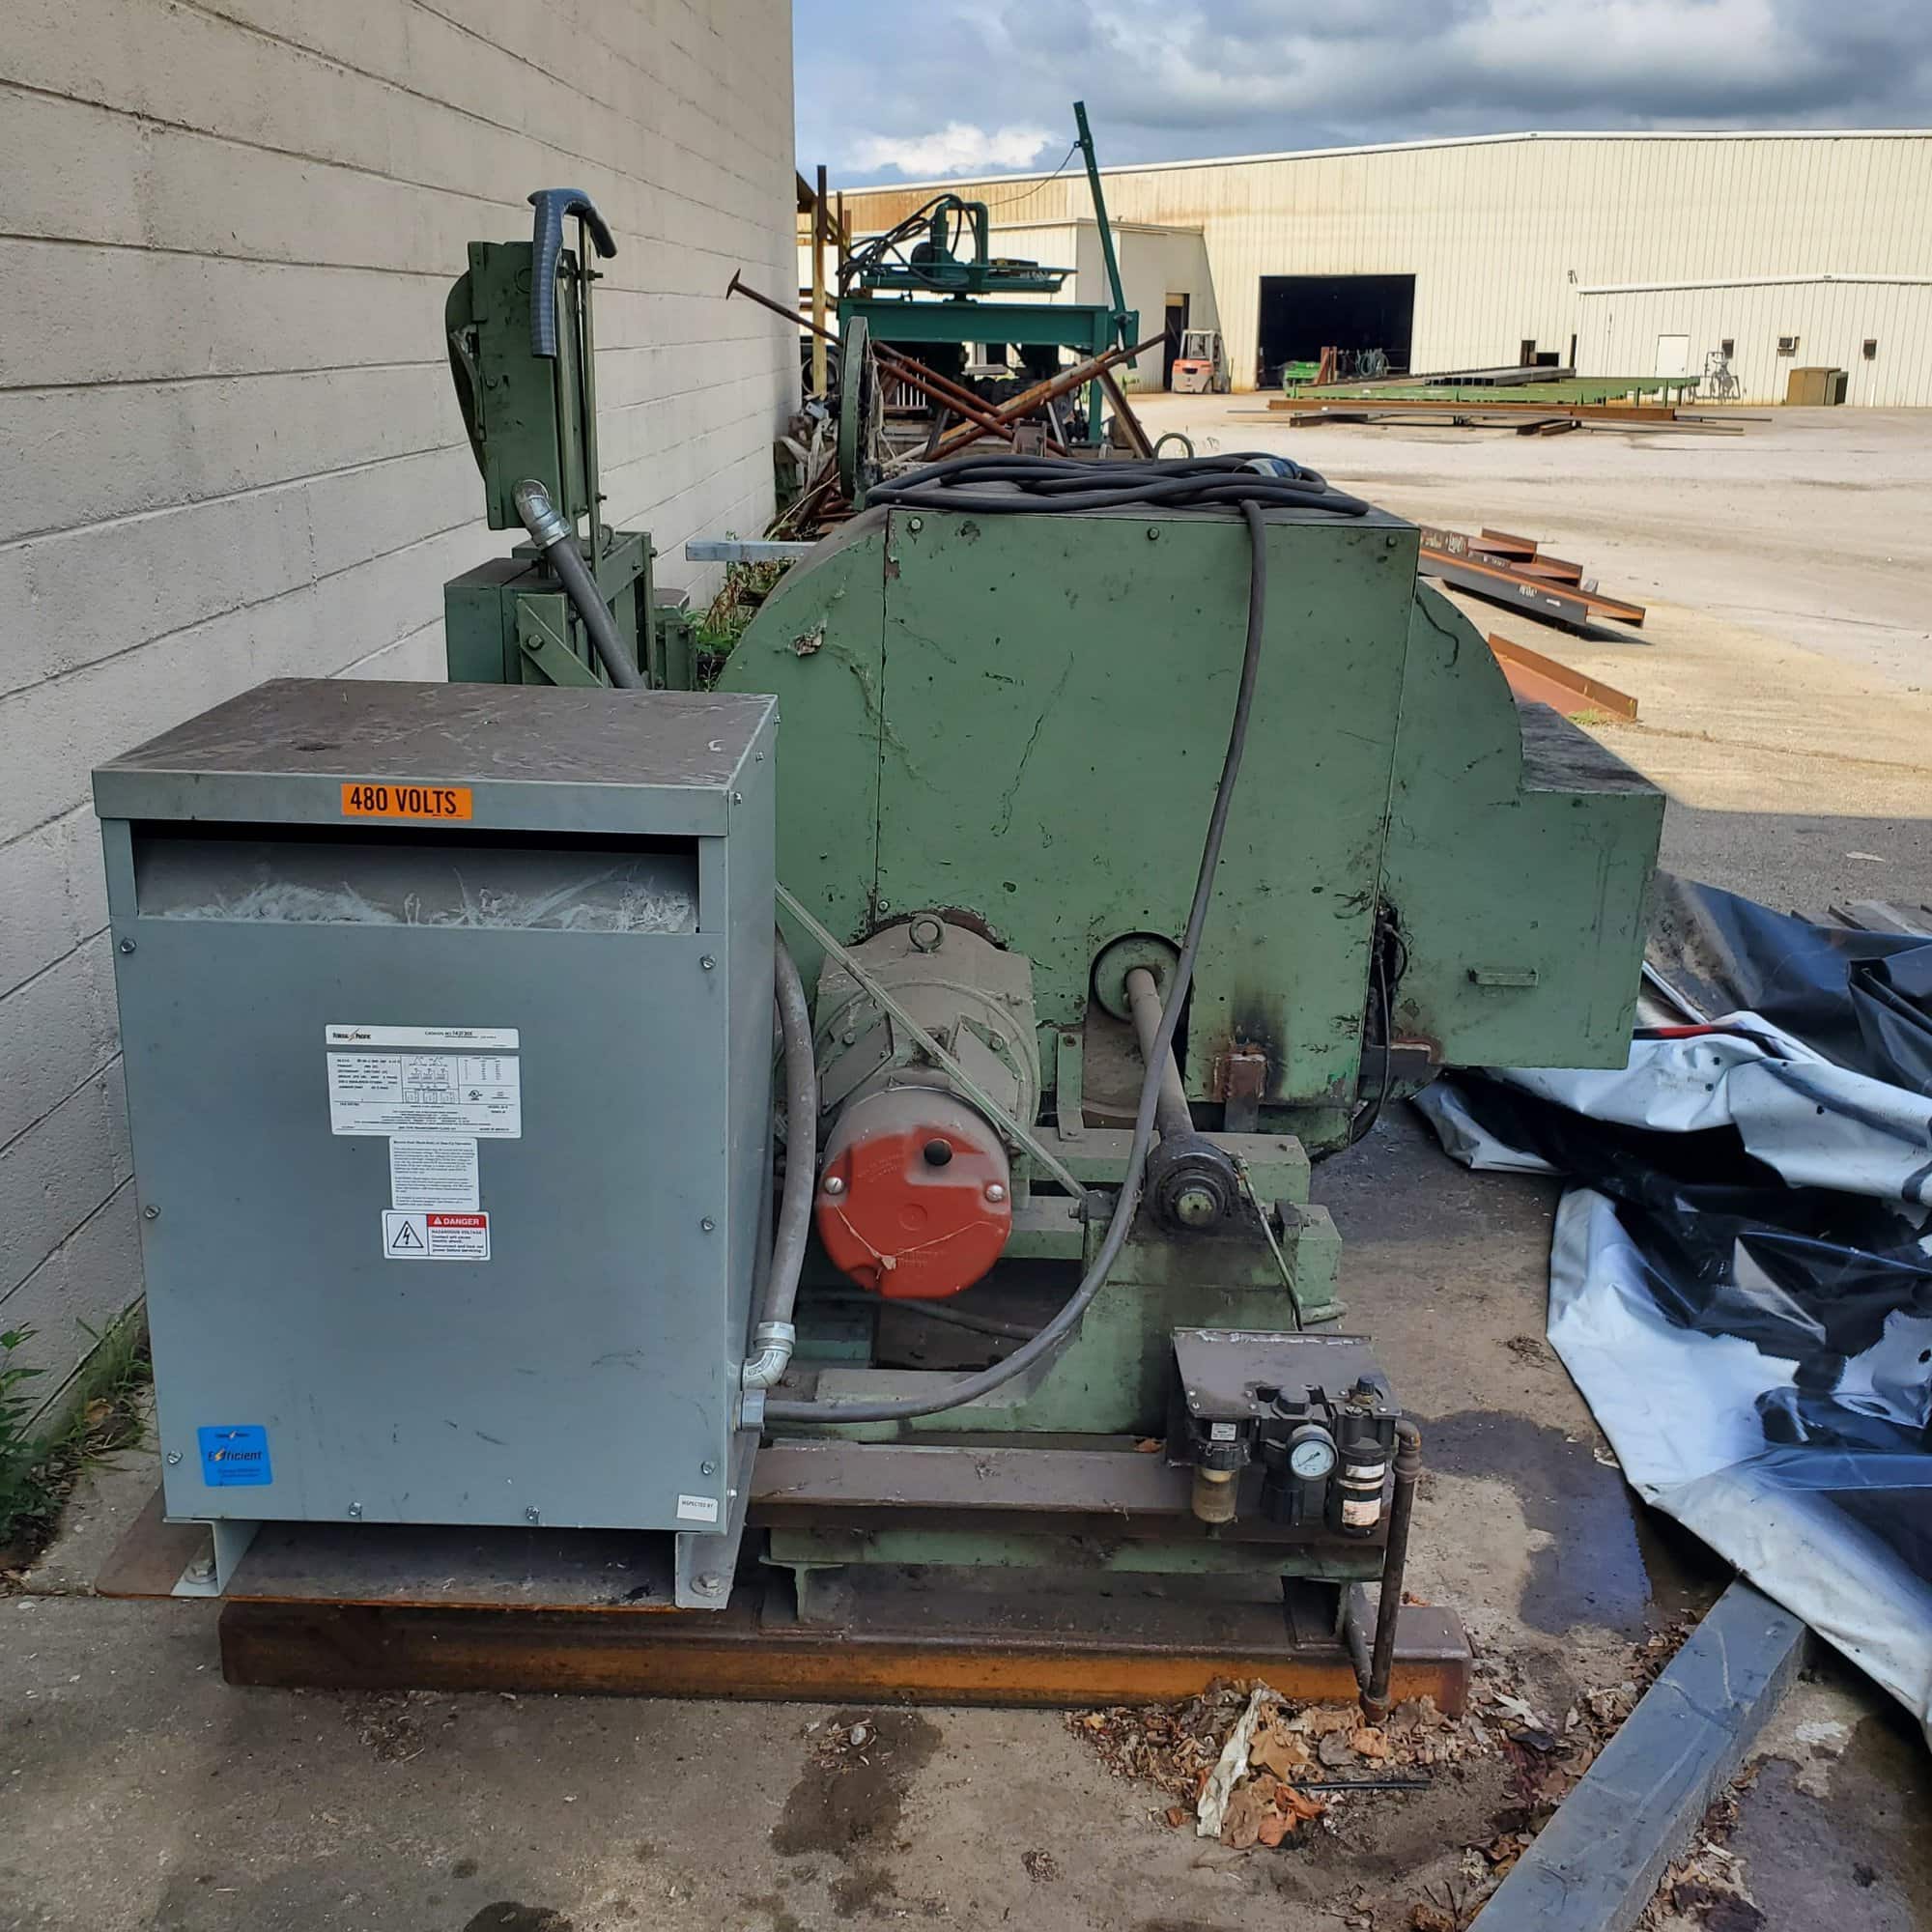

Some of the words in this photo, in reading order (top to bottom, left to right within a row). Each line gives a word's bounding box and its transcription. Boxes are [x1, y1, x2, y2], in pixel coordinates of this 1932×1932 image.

[351, 786, 387, 811] 480
[395, 788, 457, 814] VOLTS
[442, 1217, 480, 1226] DANGER
